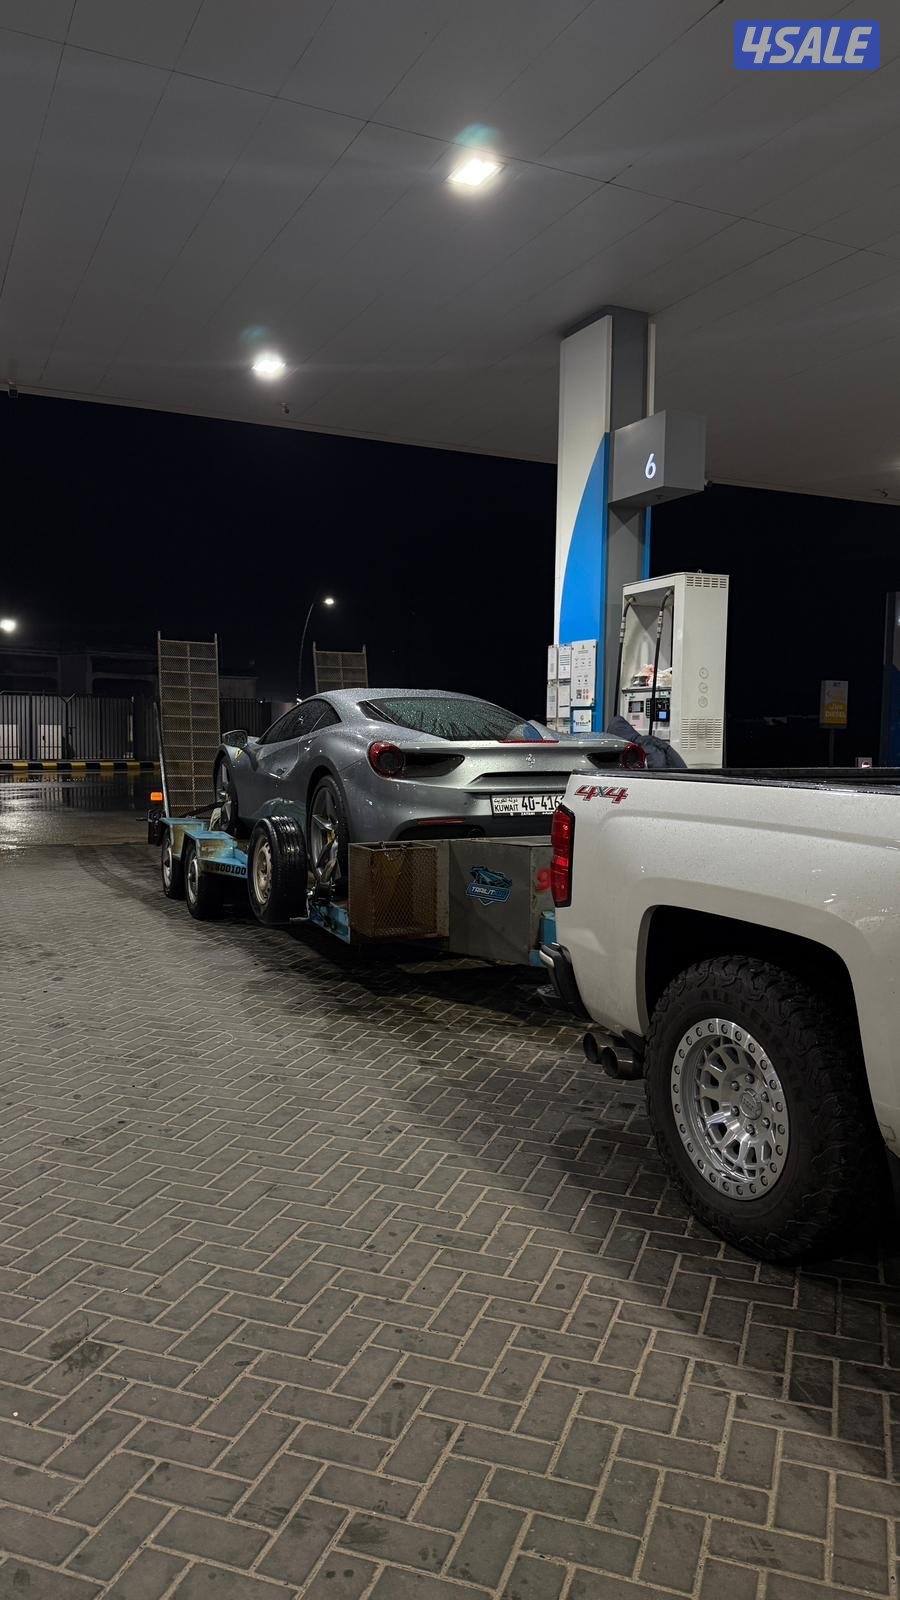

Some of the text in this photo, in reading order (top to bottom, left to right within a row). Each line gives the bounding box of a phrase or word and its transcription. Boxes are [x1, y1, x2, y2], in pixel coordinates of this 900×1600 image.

[645, 453, 656, 479] 6
[494, 804, 518, 812] KUWAIT
[521, 795, 564, 811] 40-416
